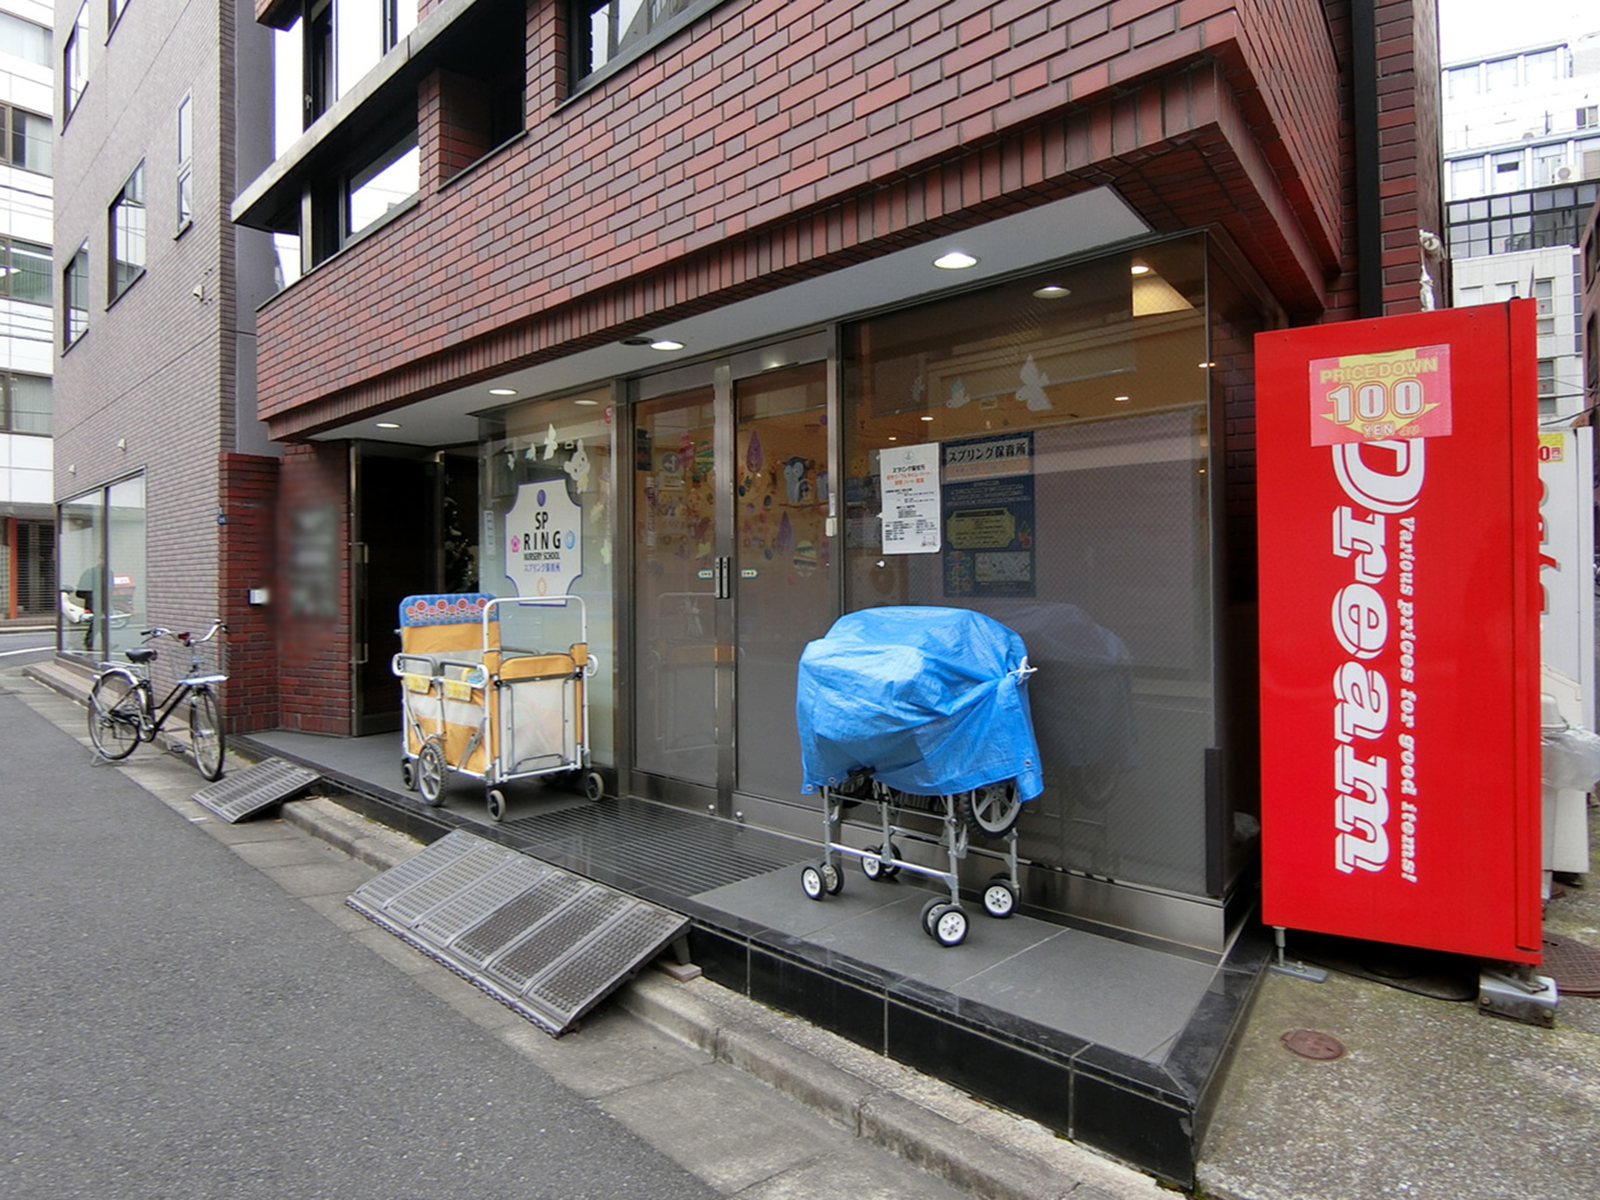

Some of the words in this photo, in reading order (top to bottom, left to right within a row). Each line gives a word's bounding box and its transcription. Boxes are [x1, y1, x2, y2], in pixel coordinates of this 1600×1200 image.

[1320, 364, 1375, 384] PRICE
[1378, 356, 1438, 377] DOWN
[1327, 379, 1424, 424] 100
[1363, 421, 1395, 438] YEN
[948, 442, 1026, 463] スプリング保育所
[523, 530, 561, 550] RING
[535, 511, 549, 530] SP
[523, 552, 542, 561] NURSERY
[543, 551, 561, 560] SCHOOL
[1397, 517, 1415, 596] Various
[1330, 437, 1426, 873] Dream
[1396, 599, 1415, 682] prices
[1399, 689, 1417, 728] for
[1397, 733, 1417, 794] good
[1399, 802, 1417, 882] items!
